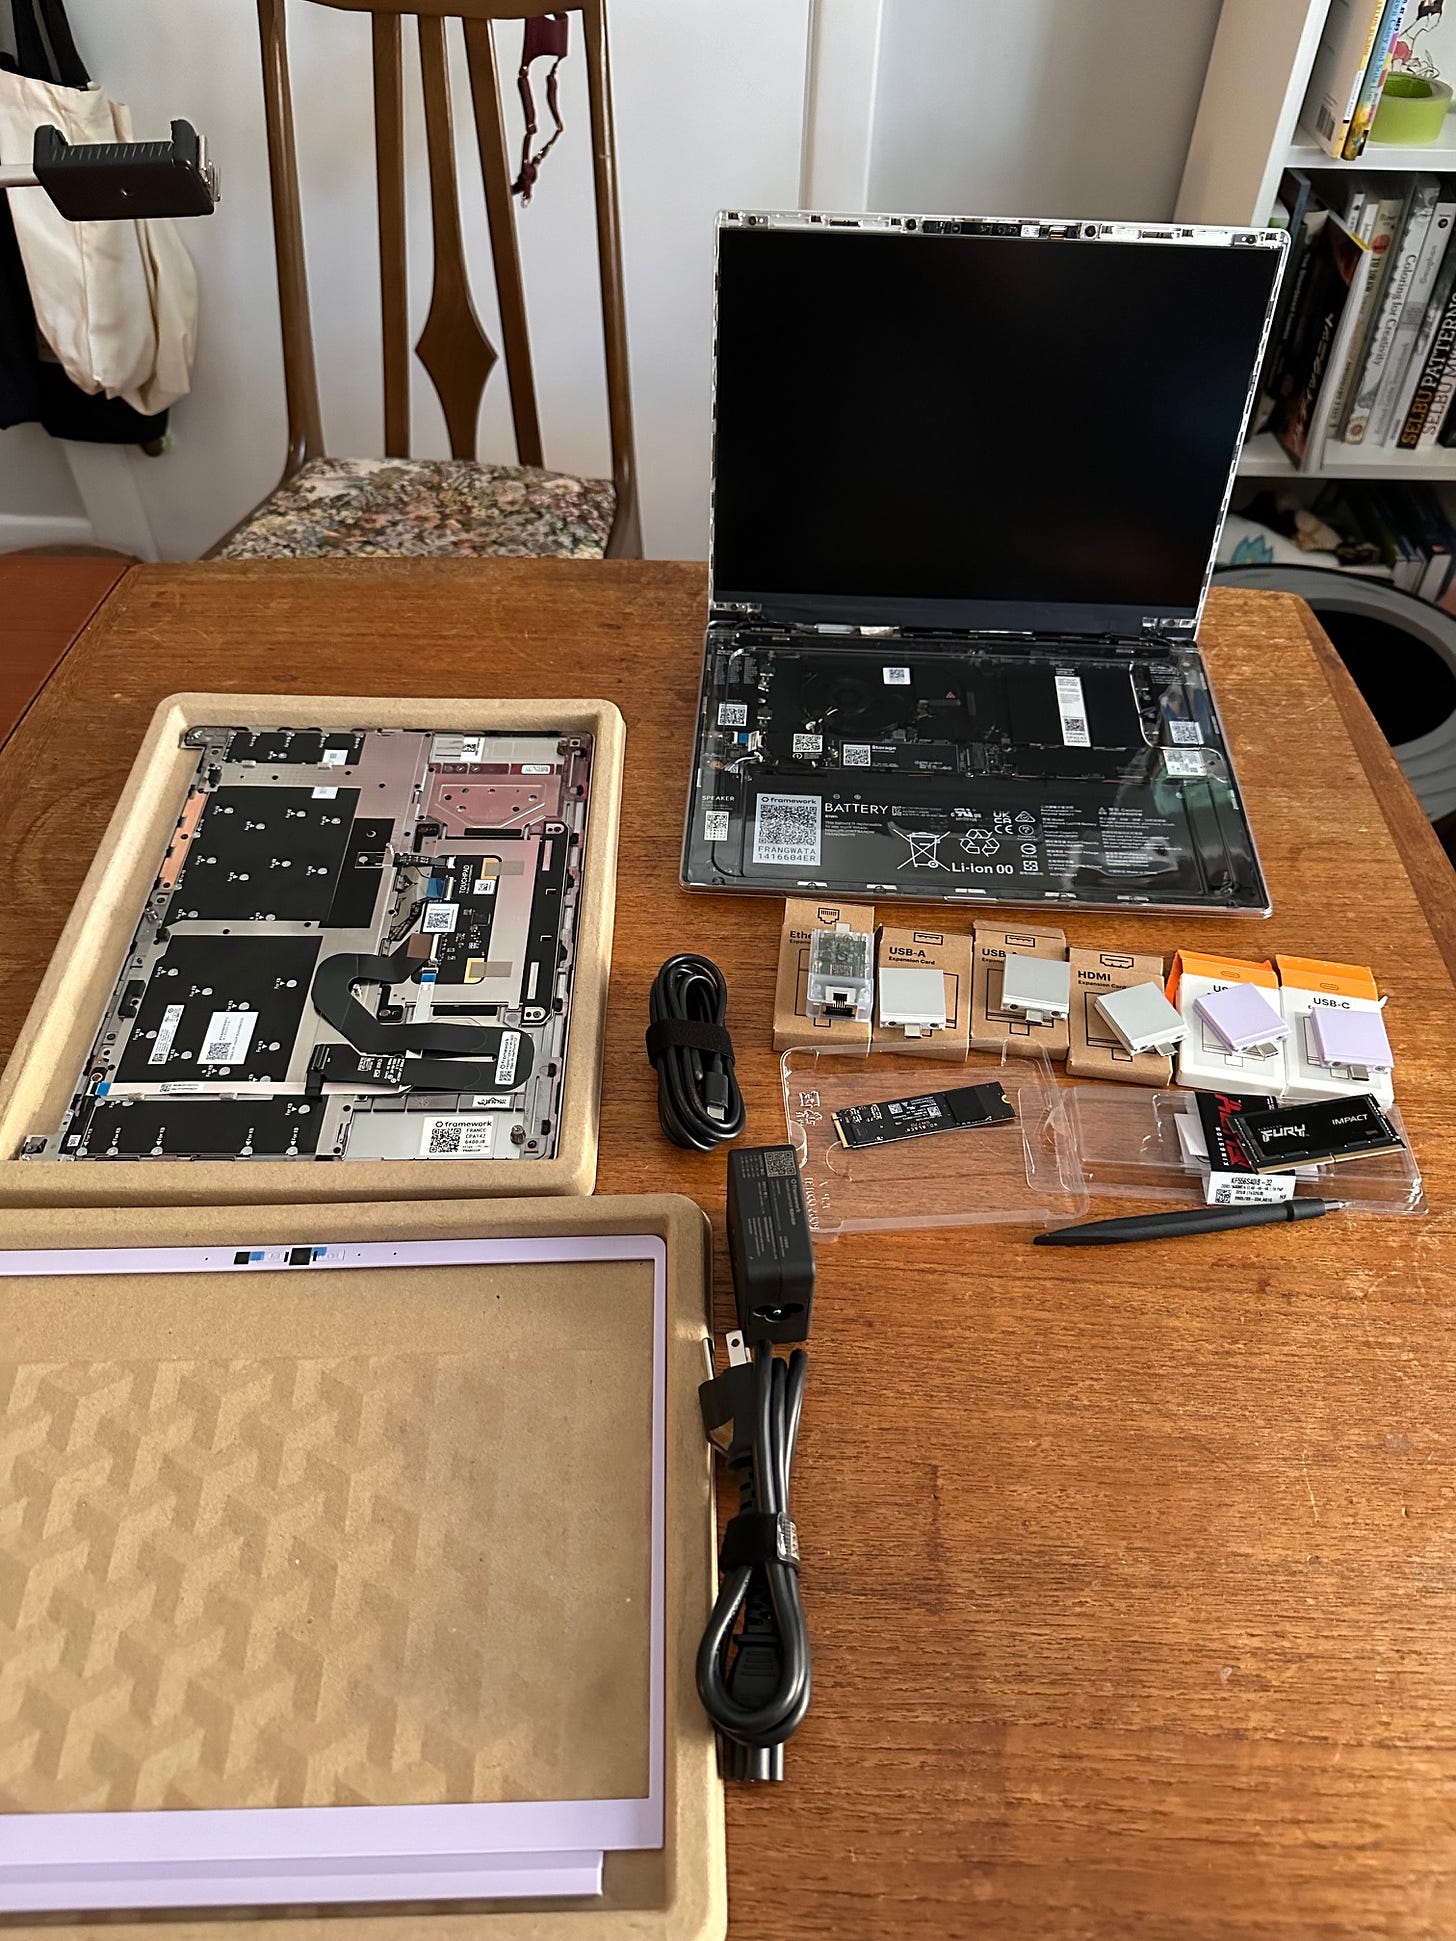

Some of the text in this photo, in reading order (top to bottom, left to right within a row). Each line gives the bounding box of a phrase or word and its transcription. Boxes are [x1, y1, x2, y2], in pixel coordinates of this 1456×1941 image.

[1392, 254, 1416, 300] Coloring
[1422, 375, 1453, 436] SELBU
[1401, 390, 1434, 445] SELBU
[824, 802, 888, 814] BATTERY
[758, 846, 816, 854] FRANGWATA
[952, 862, 1014, 874] Li-ion 00
[890, 947, 926, 958] USB-A
[1078, 971, 1110, 981] HDMI
[1313, 998, 1350, 1009] USB-C
[1332, 1114, 1368, 1125] IMPACT
[1260, 1124, 1306, 1142] FURY
